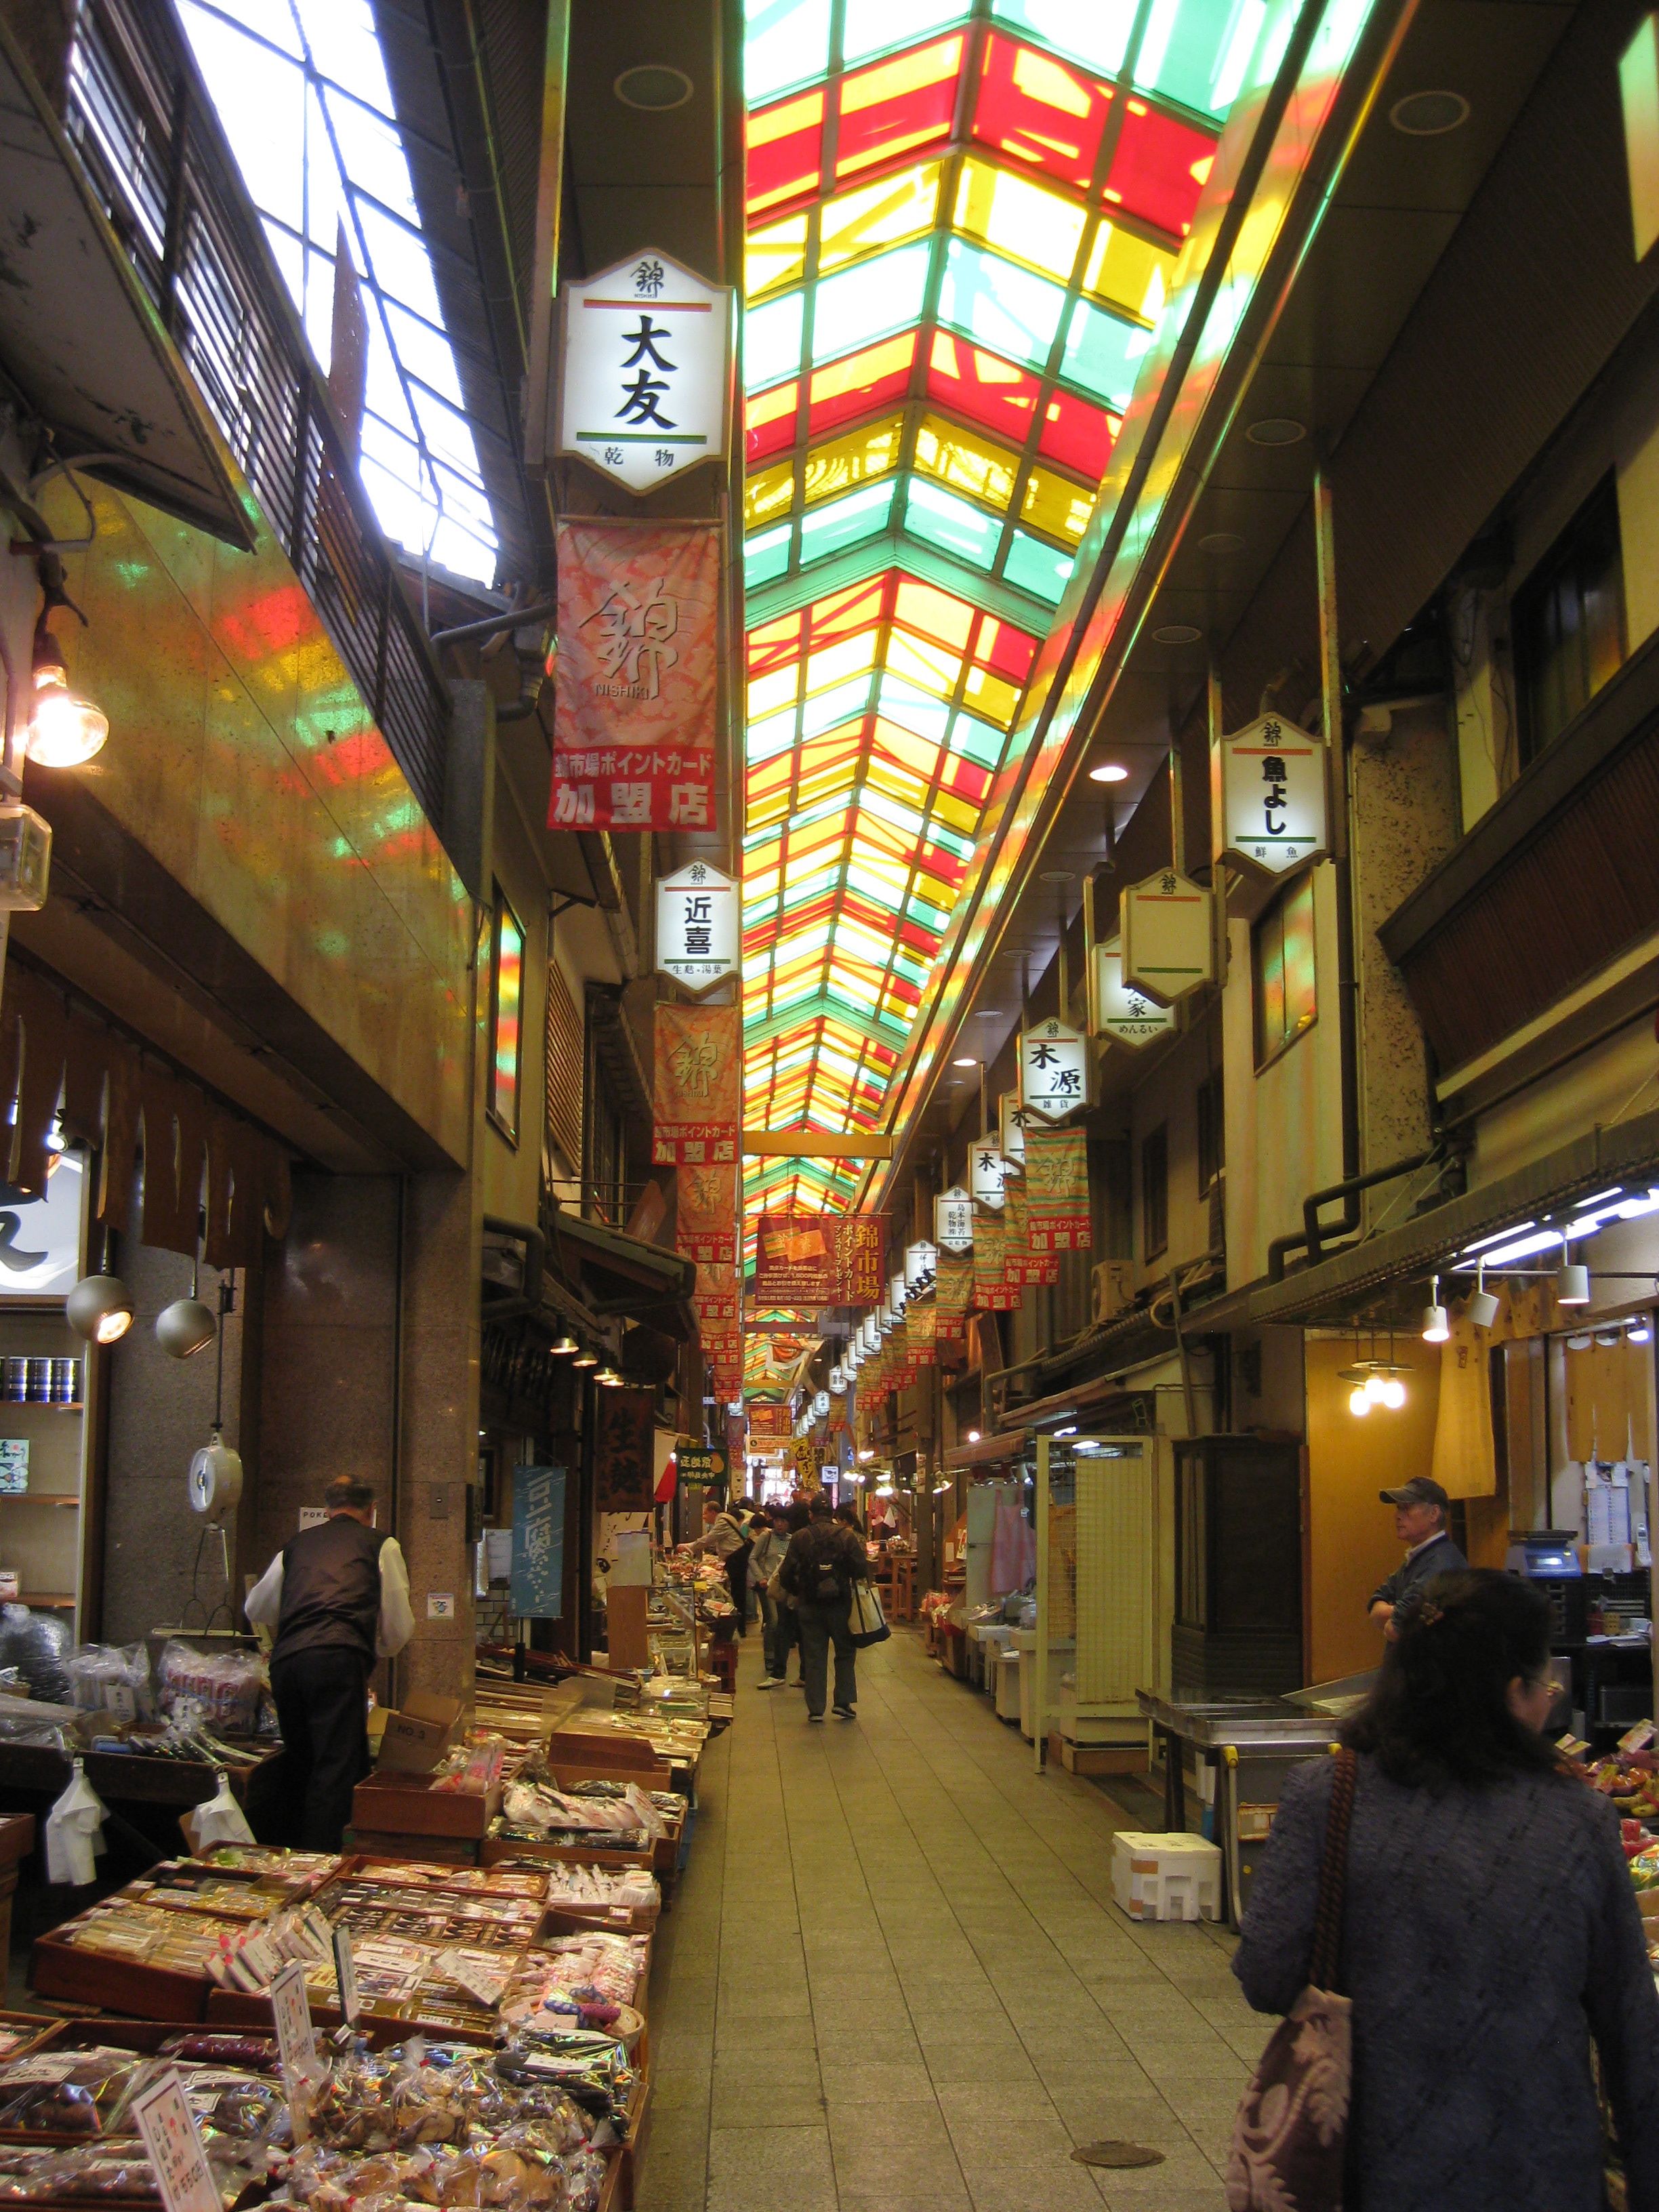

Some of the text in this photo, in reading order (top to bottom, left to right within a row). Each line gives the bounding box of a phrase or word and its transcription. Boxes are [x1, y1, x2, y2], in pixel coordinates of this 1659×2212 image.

[614, 315, 679, 430] 大友
[605, 447, 675, 467] 乾物
[594, 684, 650, 699] NISHIKI
[555, 750, 712, 778] 錦市場ポイントカード
[553, 782, 709, 825] 加盟店
[1263, 756, 1288, 836] 魚よし
[1255, 845, 1298, 859] 鮮魚
[684, 896, 712, 954] 近喜
[1128, 990, 1147, 1017] 家
[1119, 1024, 1158, 1034] めんるい
[1029, 1044, 1082, 1094] 木源
[655, 1141, 735, 1163] 加盟店
[1031, 1231, 1091, 1250] 加盟店
[843, 1225, 854, 1302] ポイントカード
[855, 1224, 880, 1300] 錦市場
